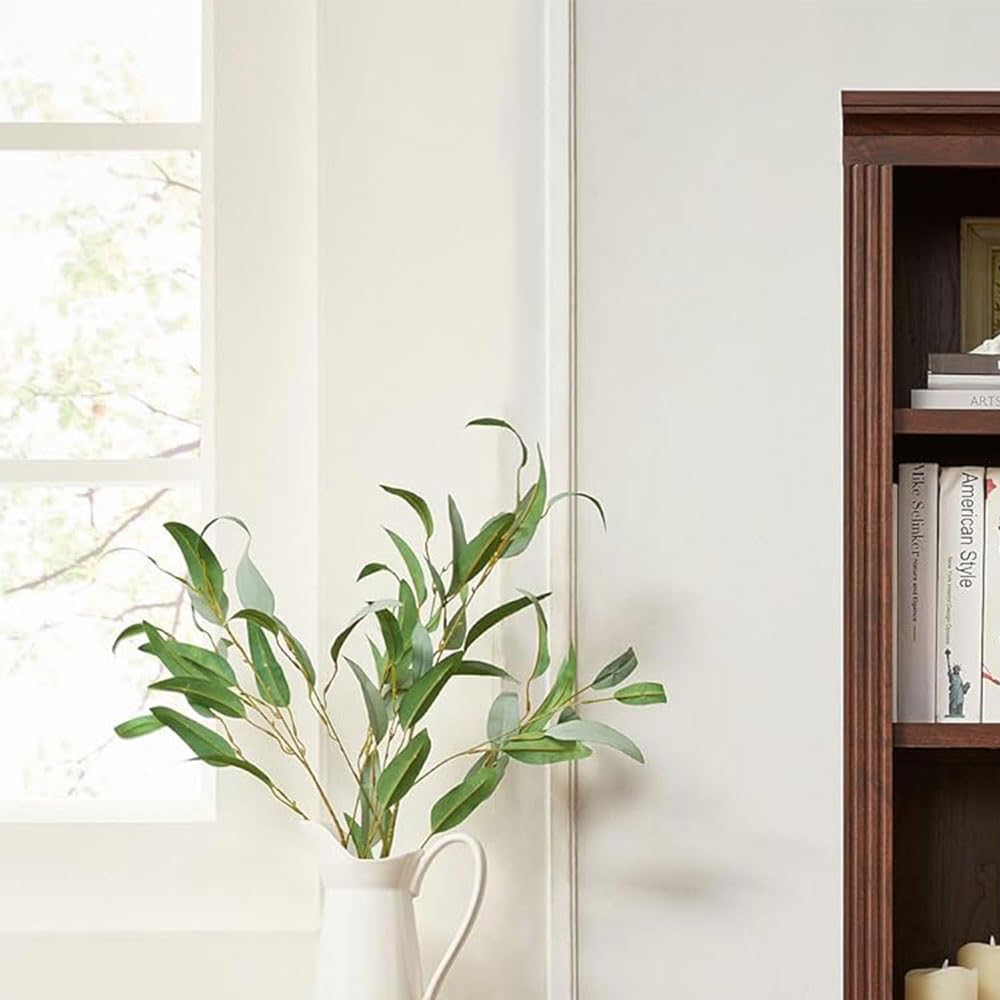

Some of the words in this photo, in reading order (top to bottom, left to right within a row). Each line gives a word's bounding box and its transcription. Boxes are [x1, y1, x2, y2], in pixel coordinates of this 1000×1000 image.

[911, 464, 925, 496] Mike
[911, 500, 925, 557] Selinker
[960, 472, 979, 545] American
[955, 550, 977, 588] Style
